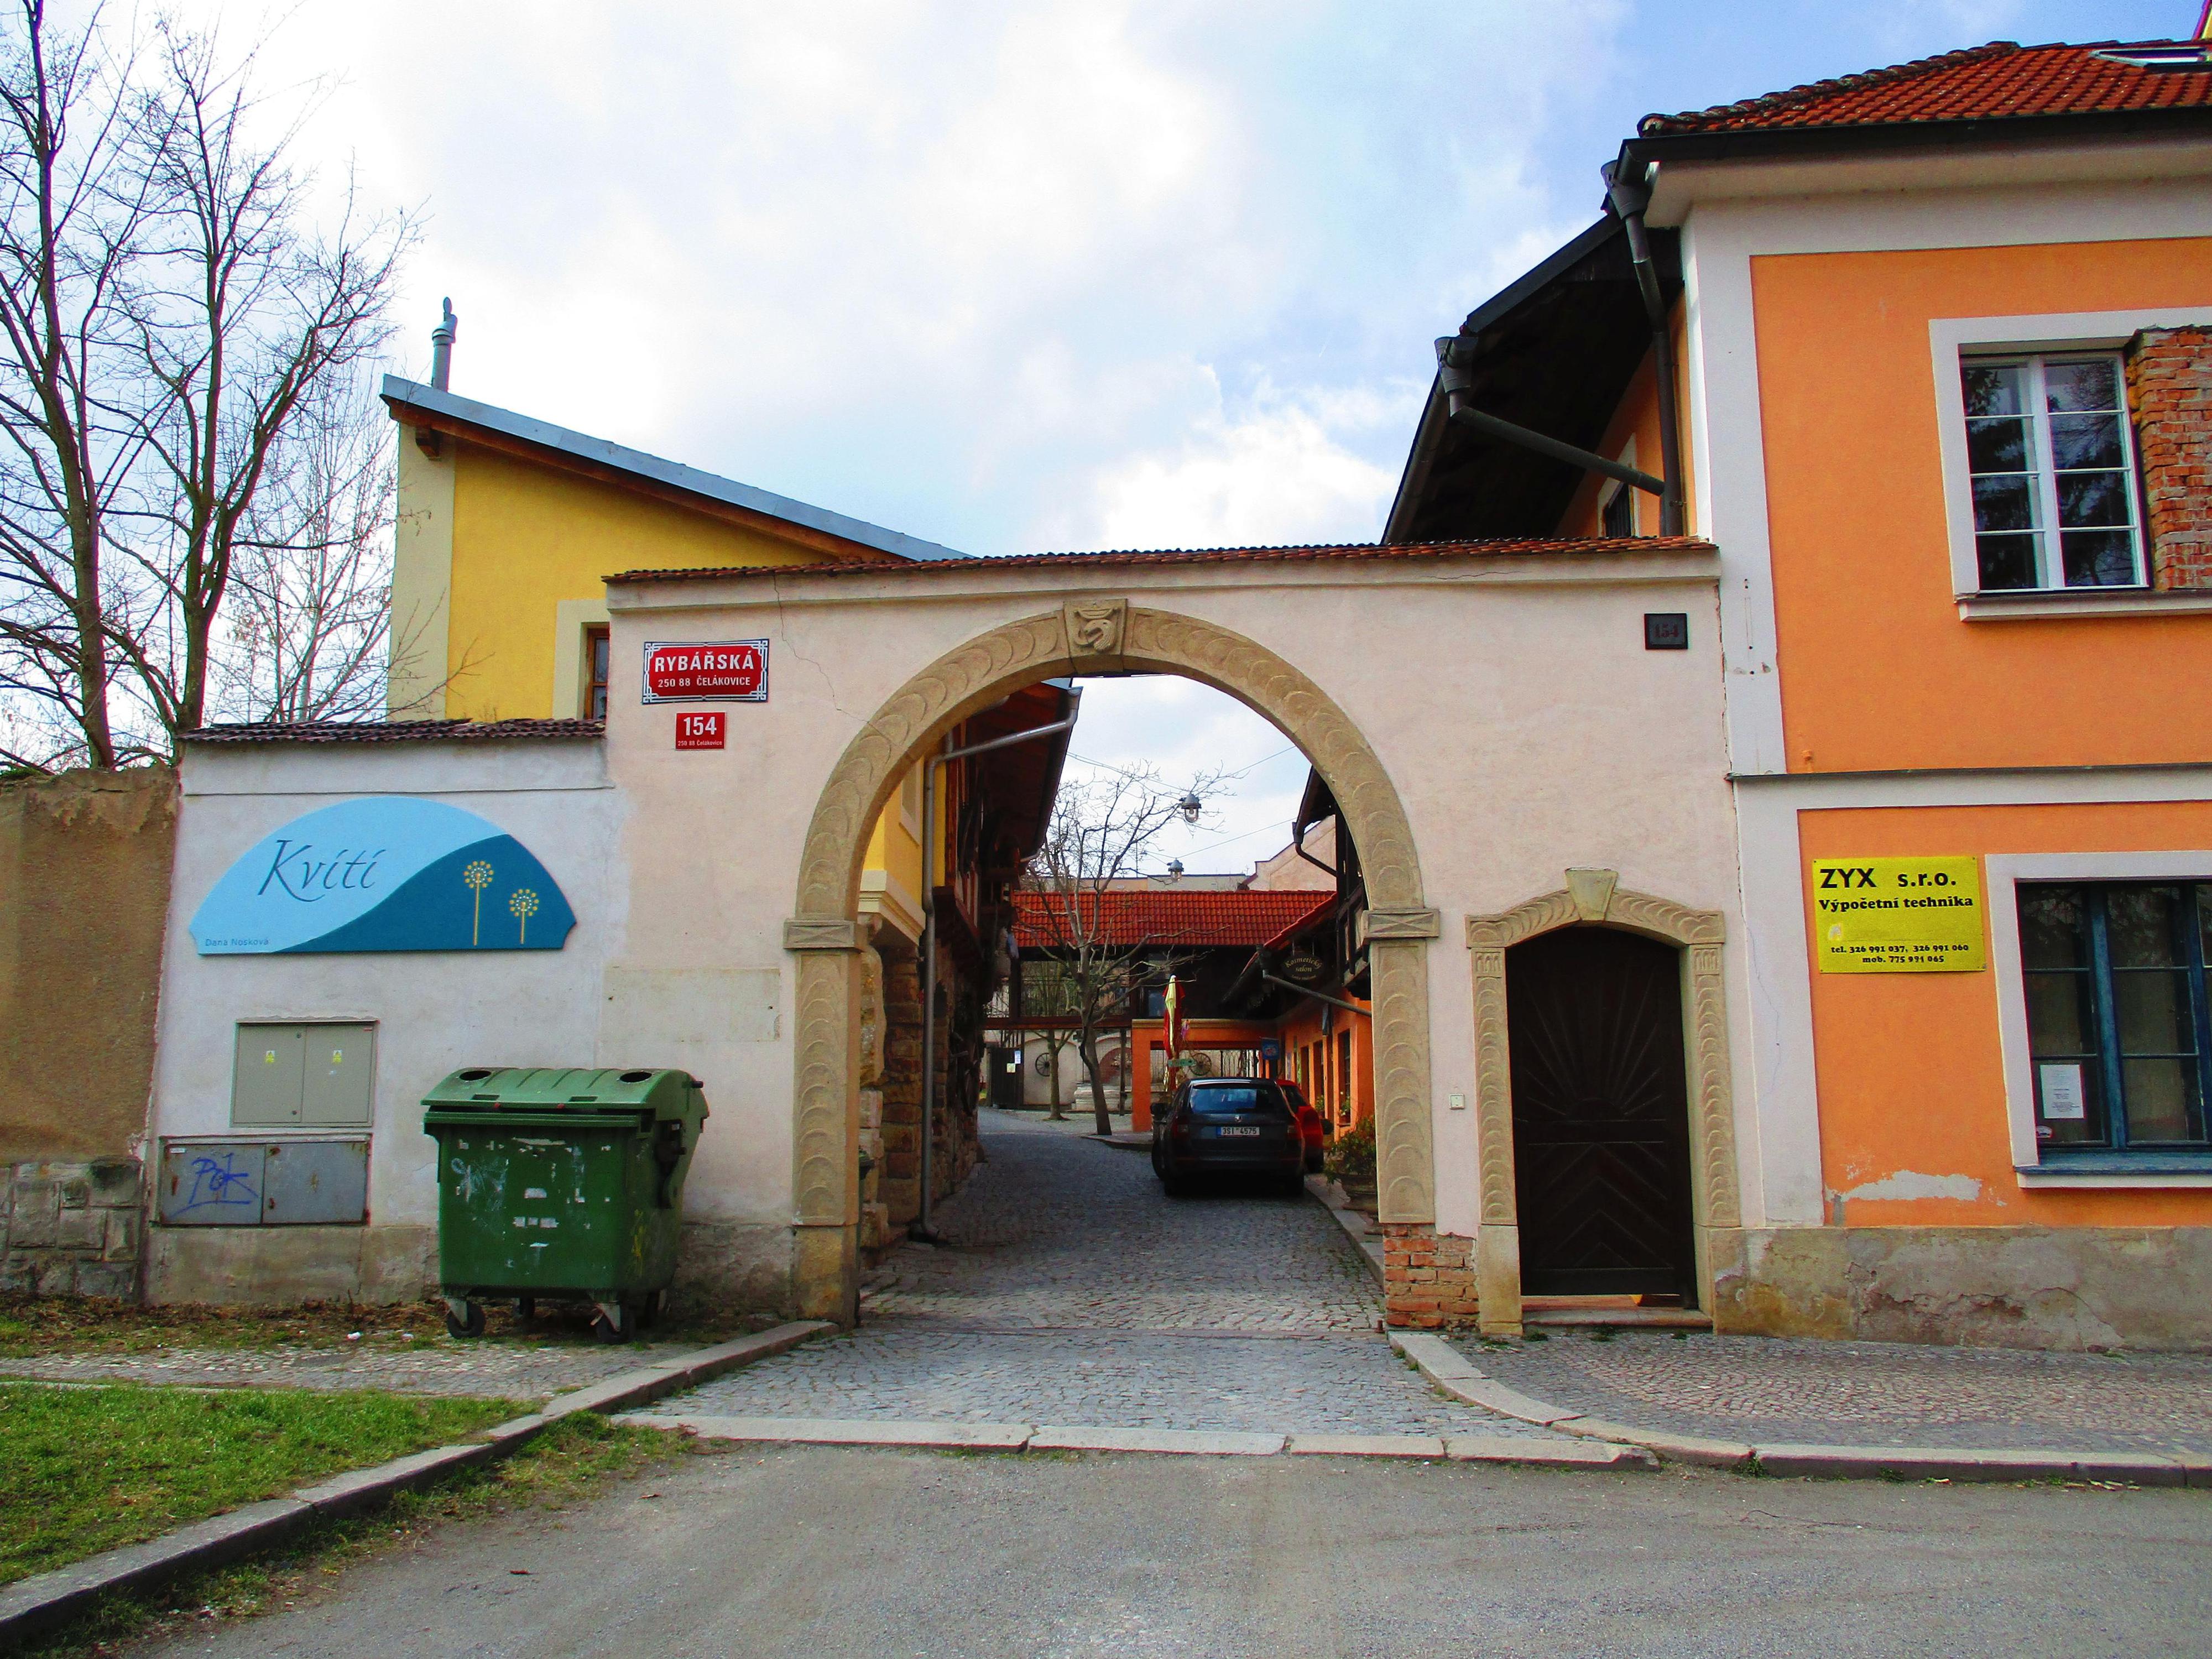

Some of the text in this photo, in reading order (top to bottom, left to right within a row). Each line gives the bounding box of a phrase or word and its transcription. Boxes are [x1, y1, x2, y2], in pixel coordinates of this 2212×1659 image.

[655, 651, 754, 672] RYBÁŘSKÁ
[658, 675, 750, 687] 250 88 ČELÁKOVICE
[684, 717, 717, 735] 154
[258, 839, 387, 902] Kvítí
[1819, 868, 1957, 889] ZYX s.r.o.
[1819, 895, 1974, 912] Výpočetní technika
[1295, 964, 1312, 972] salon
